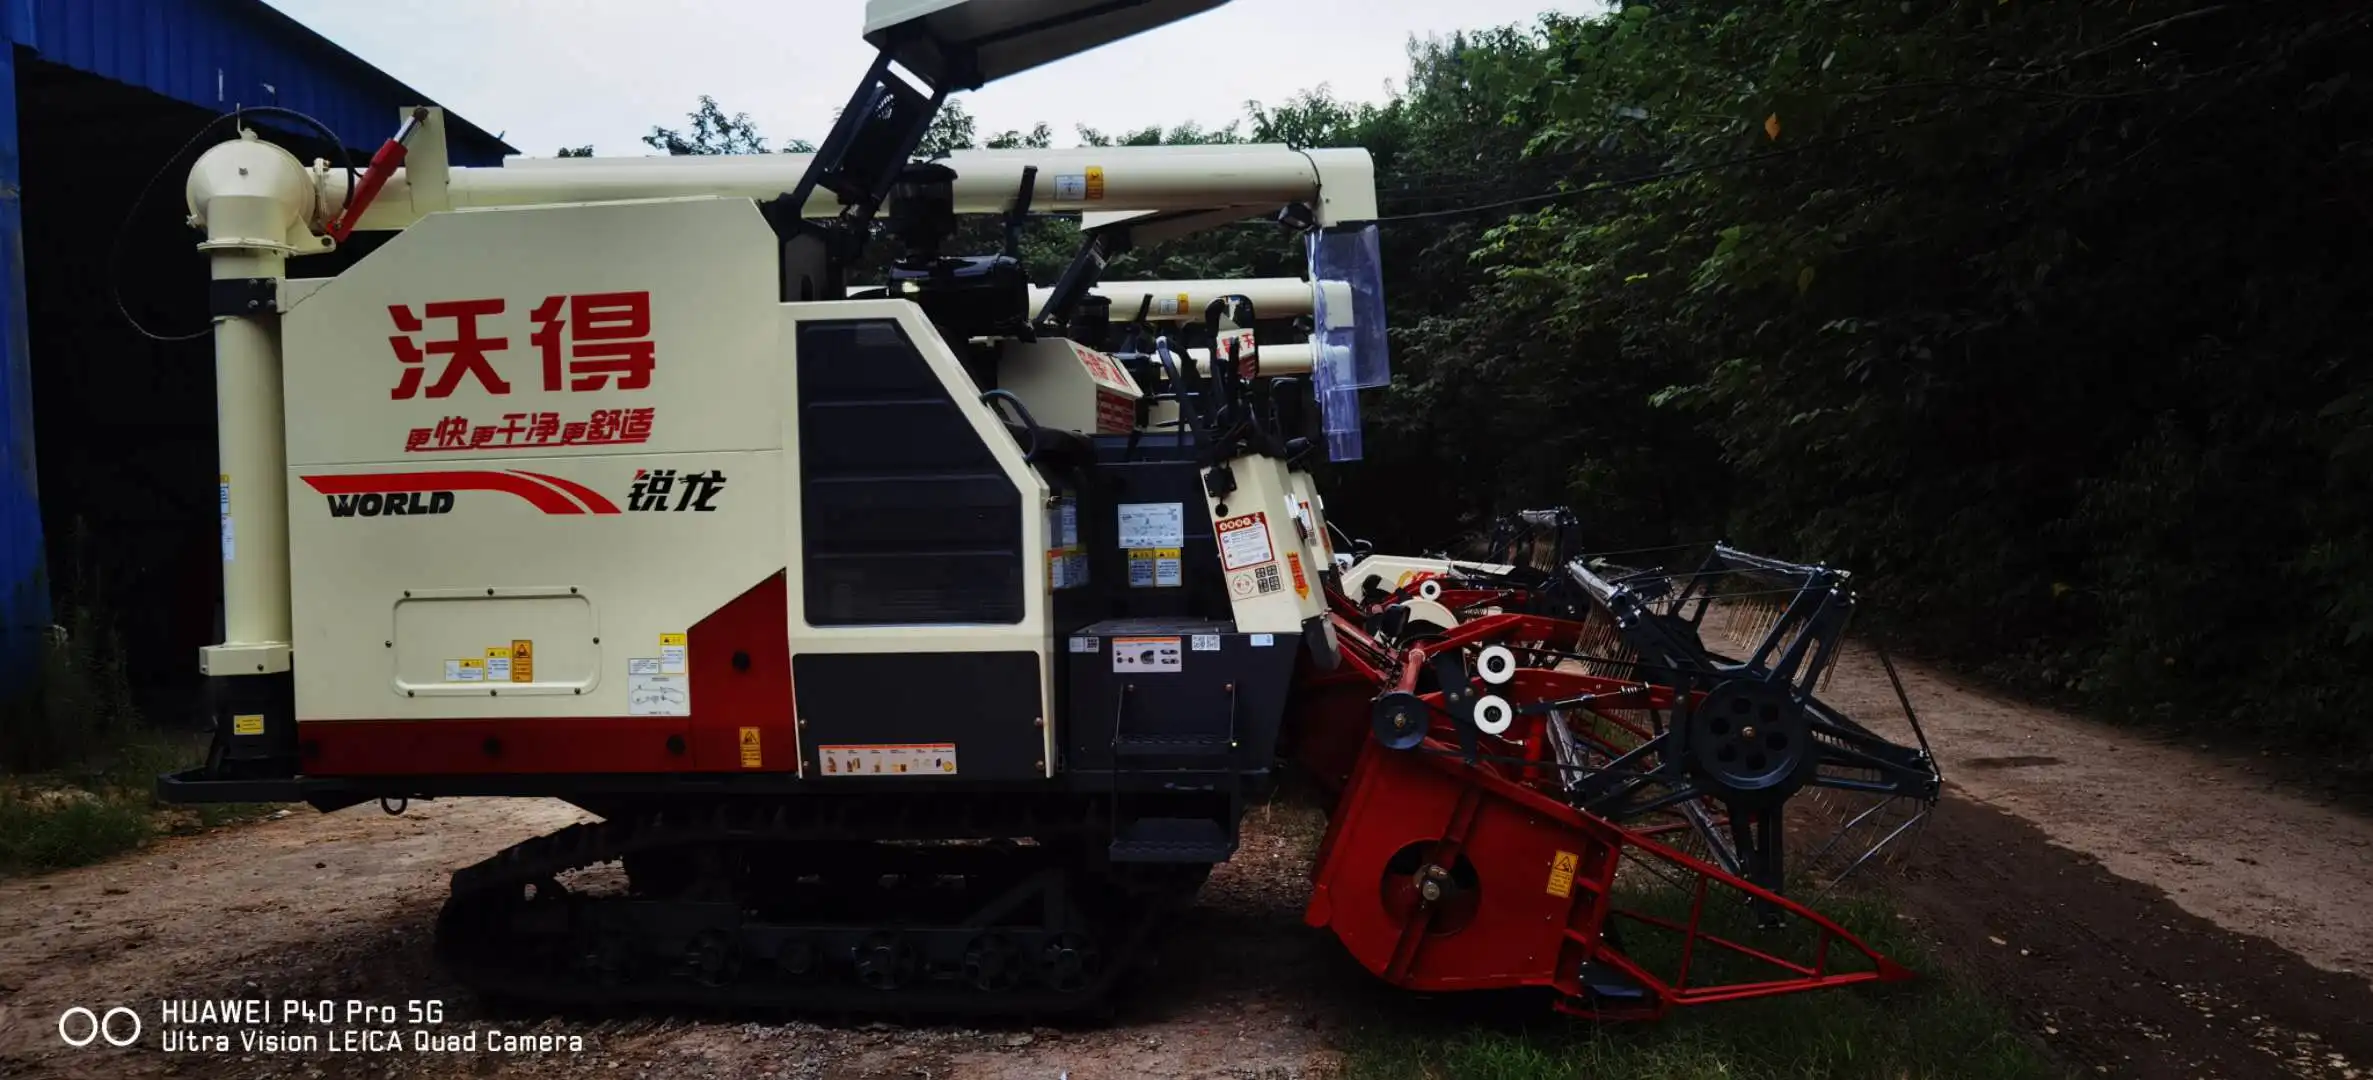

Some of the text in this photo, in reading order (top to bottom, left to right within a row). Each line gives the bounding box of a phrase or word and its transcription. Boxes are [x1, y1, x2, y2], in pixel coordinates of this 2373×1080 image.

[388, 291, 655, 399] 沃得
[405, 407, 655, 450] 更快更干净更舒适
[326, 490, 455, 518] WORLD
[627, 468, 727, 512] 锐龙
